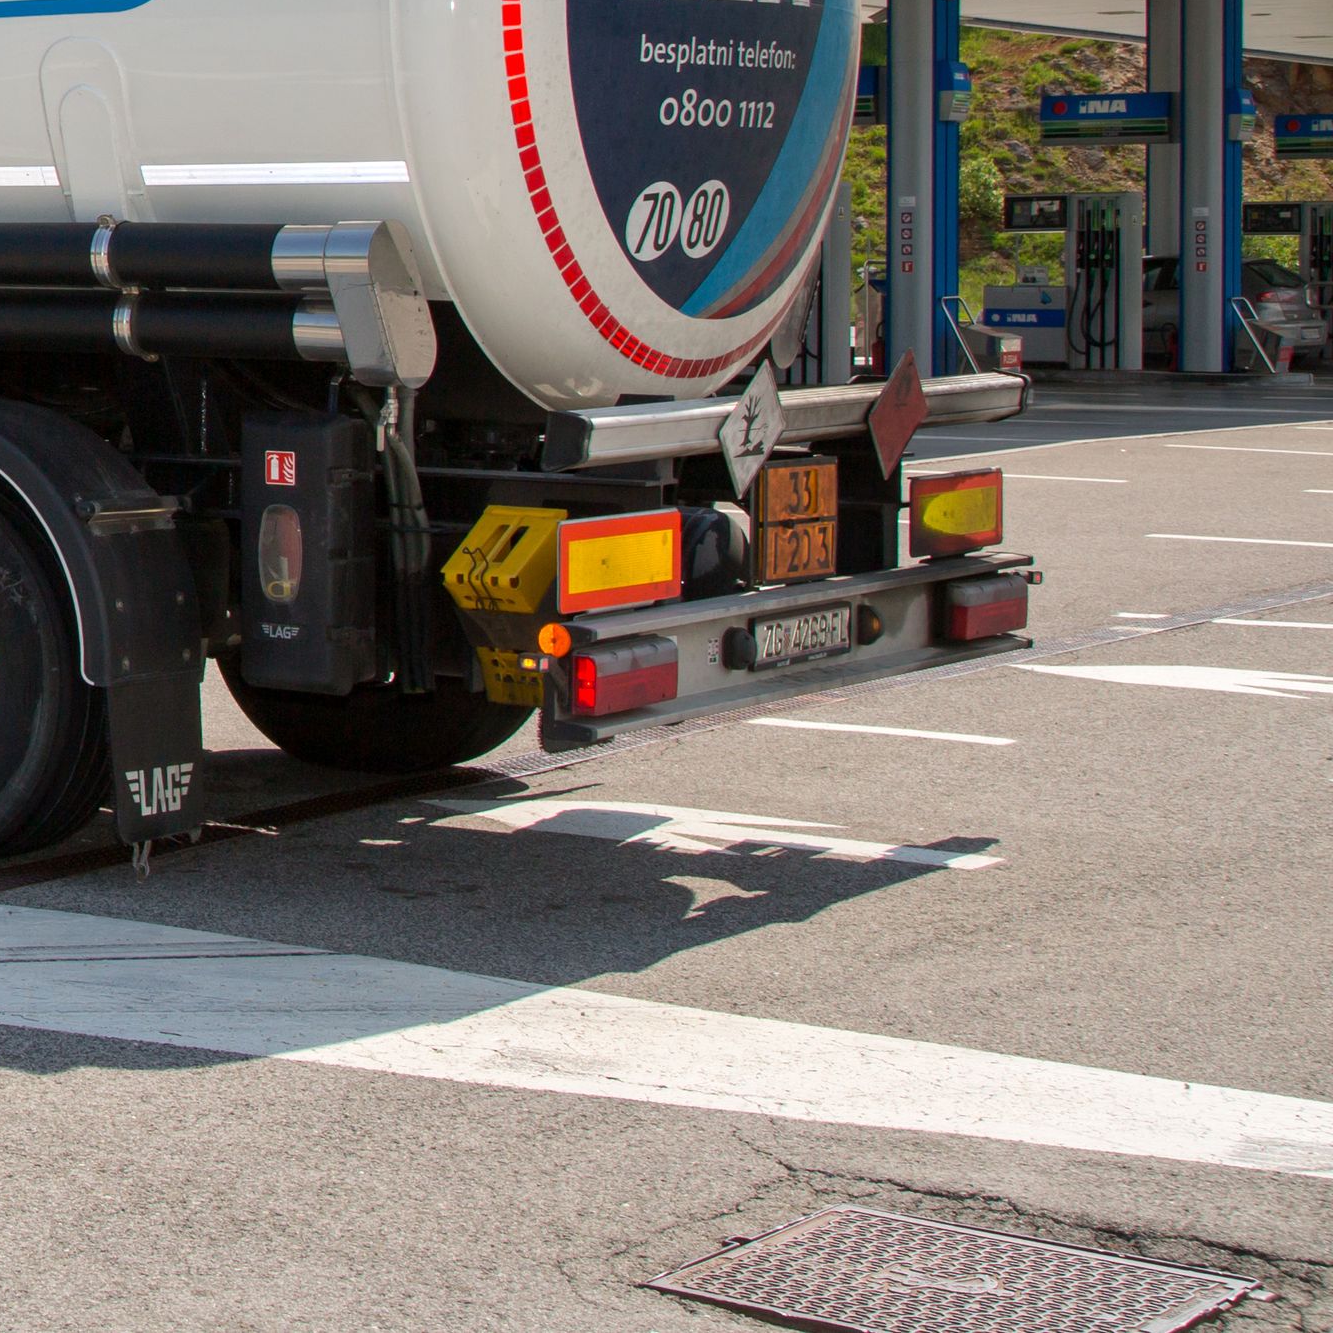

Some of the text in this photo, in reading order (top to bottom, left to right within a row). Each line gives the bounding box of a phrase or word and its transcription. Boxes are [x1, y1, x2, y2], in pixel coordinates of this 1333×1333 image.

[640, 33, 796, 73] besplatni telefon:
[659, 88, 775, 128] 0800 1112
[634, 188, 724, 254] 70 80
[788, 470, 813, 514] 33
[268, 624, 293, 640] LAG
[763, 622, 782, 659] ZG
[138, 764, 182, 817] LAG
